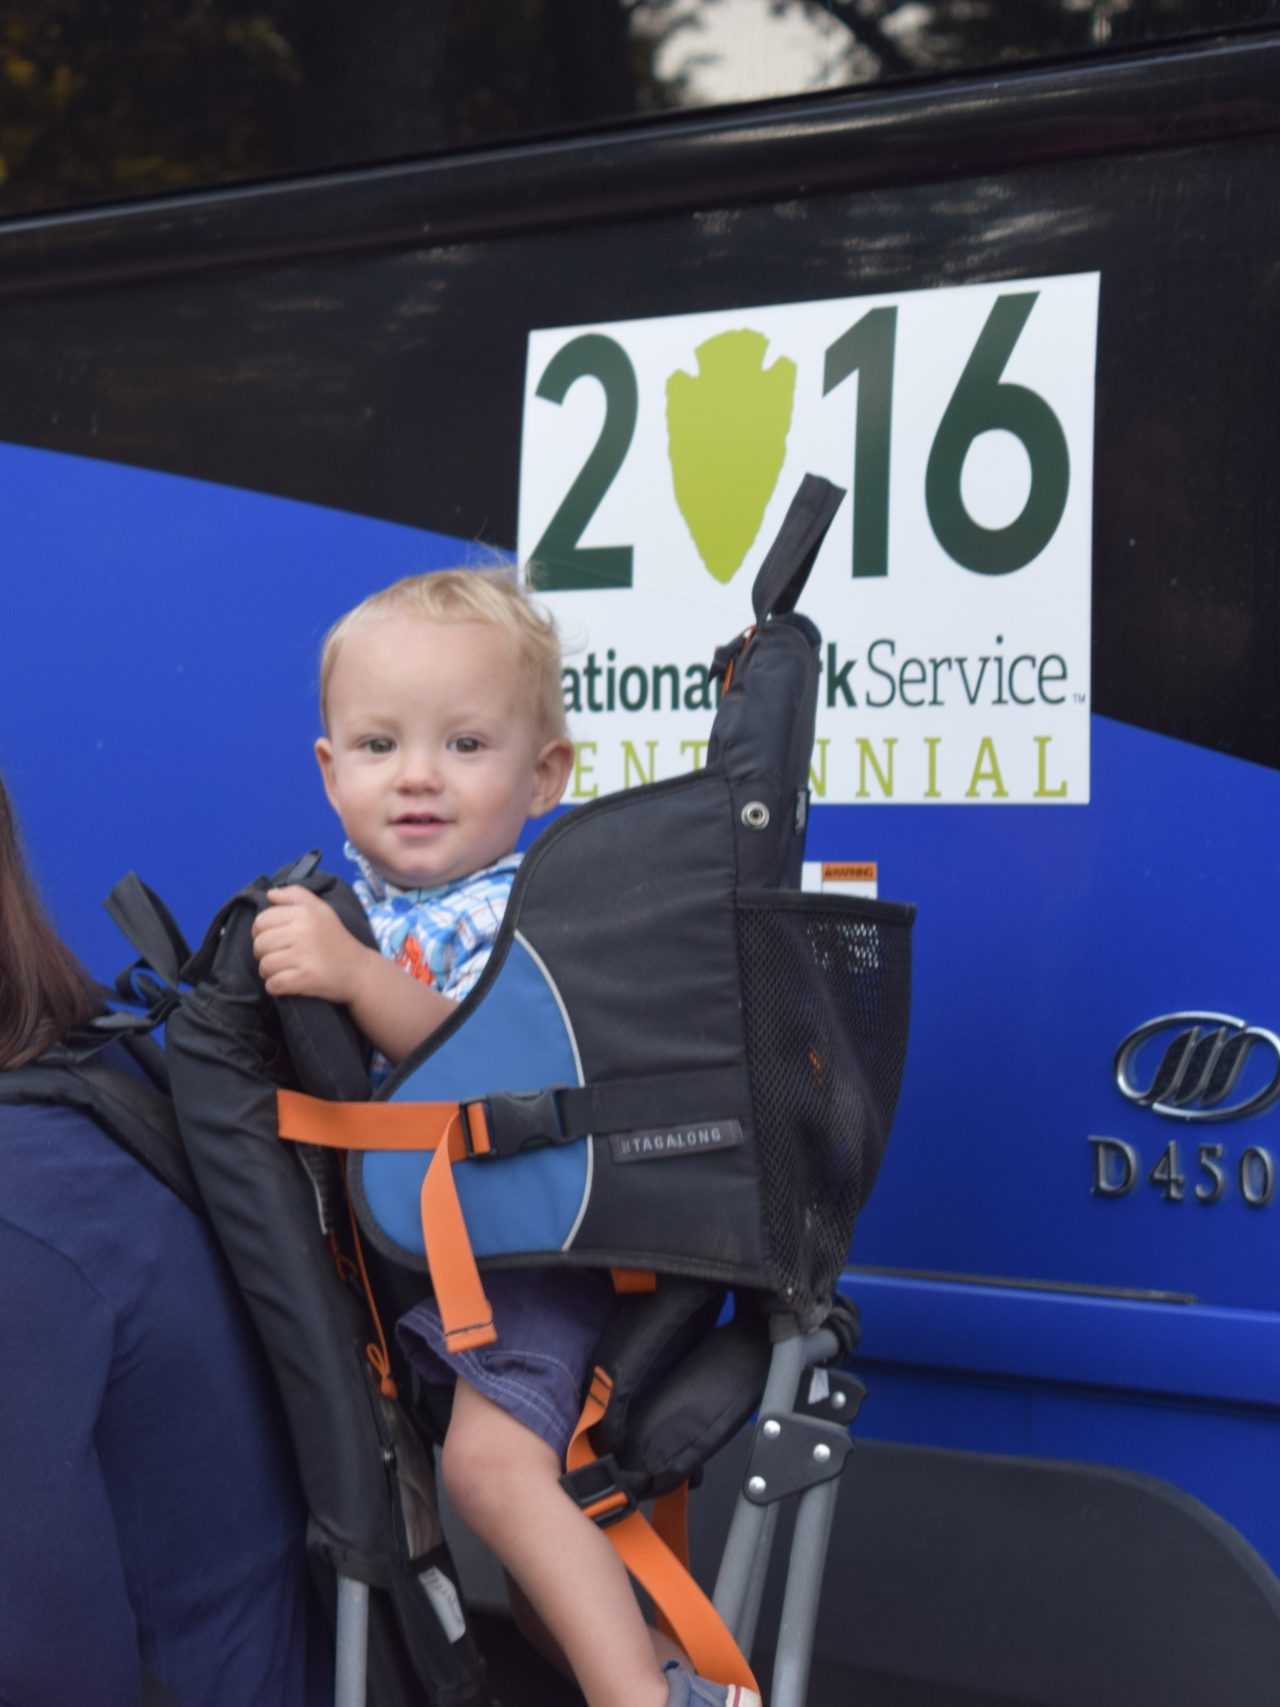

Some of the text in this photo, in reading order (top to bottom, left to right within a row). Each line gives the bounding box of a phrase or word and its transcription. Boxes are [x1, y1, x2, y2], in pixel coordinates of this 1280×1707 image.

[562, 648, 722, 713] ationa
[866, 635, 1068, 708] Service
[632, 1127, 722, 1153] TAGALONG
